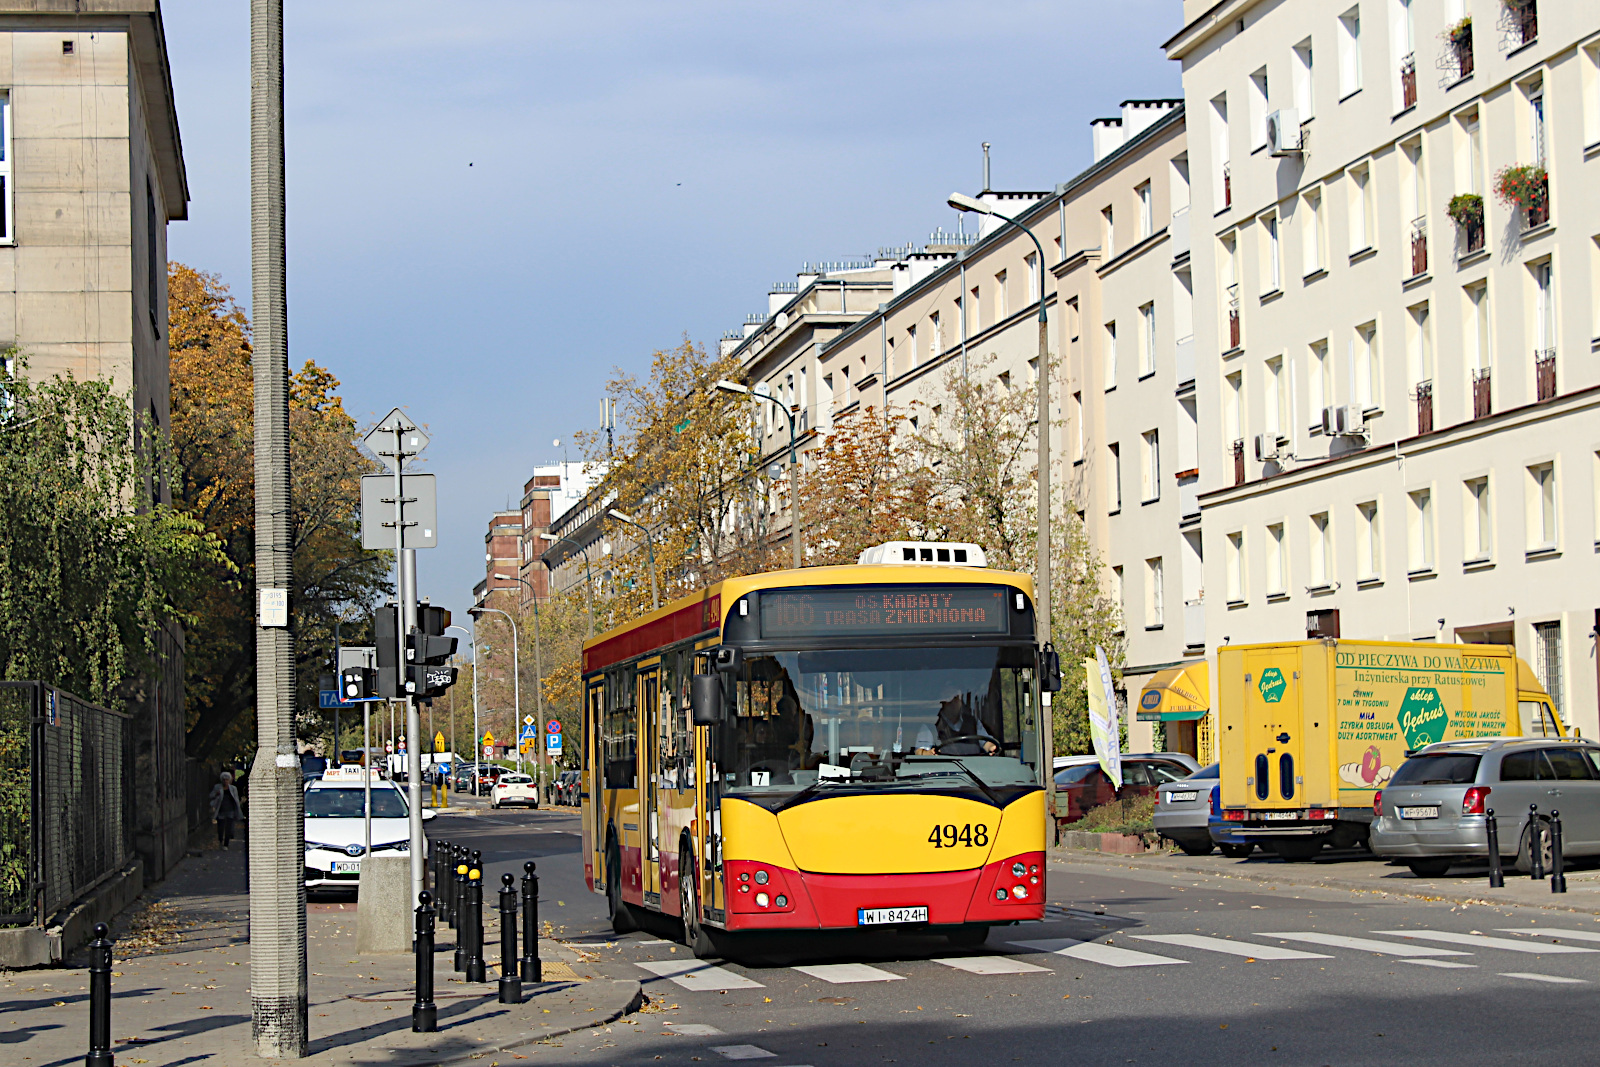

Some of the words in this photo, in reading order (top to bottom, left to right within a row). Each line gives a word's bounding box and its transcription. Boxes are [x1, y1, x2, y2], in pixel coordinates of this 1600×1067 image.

[774, 594, 814, 626] 166
[824, 610, 880, 625] TRASA
[885, 608, 986, 624] ZMIENIONA
[1336, 652, 1354, 666] OD
[1358, 653, 1418, 668] PIECZYWA
[1423, 656, 1442, 668] DO
[1444, 656, 1501, 670] WARZYWA
[1354, 670, 1409, 686] Inżynierska
[1411, 675, 1432, 688] przy
[1434, 673, 1486, 688] Ratuszowej
[1410, 689, 1434, 704] sklep
[1359, 712, 1375, 720] MIŁA
[1403, 701, 1444, 737] Jędruś
[1340, 721, 1364, 730] SZYBKA
[1482, 721, 1507, 730] WARZYW
[1356, 732, 1398, 741] ASORTYMENT
[757, 772, 764, 786] 7
[928, 824, 989, 848] 4948
[888, 908, 926, 922] 8424H
